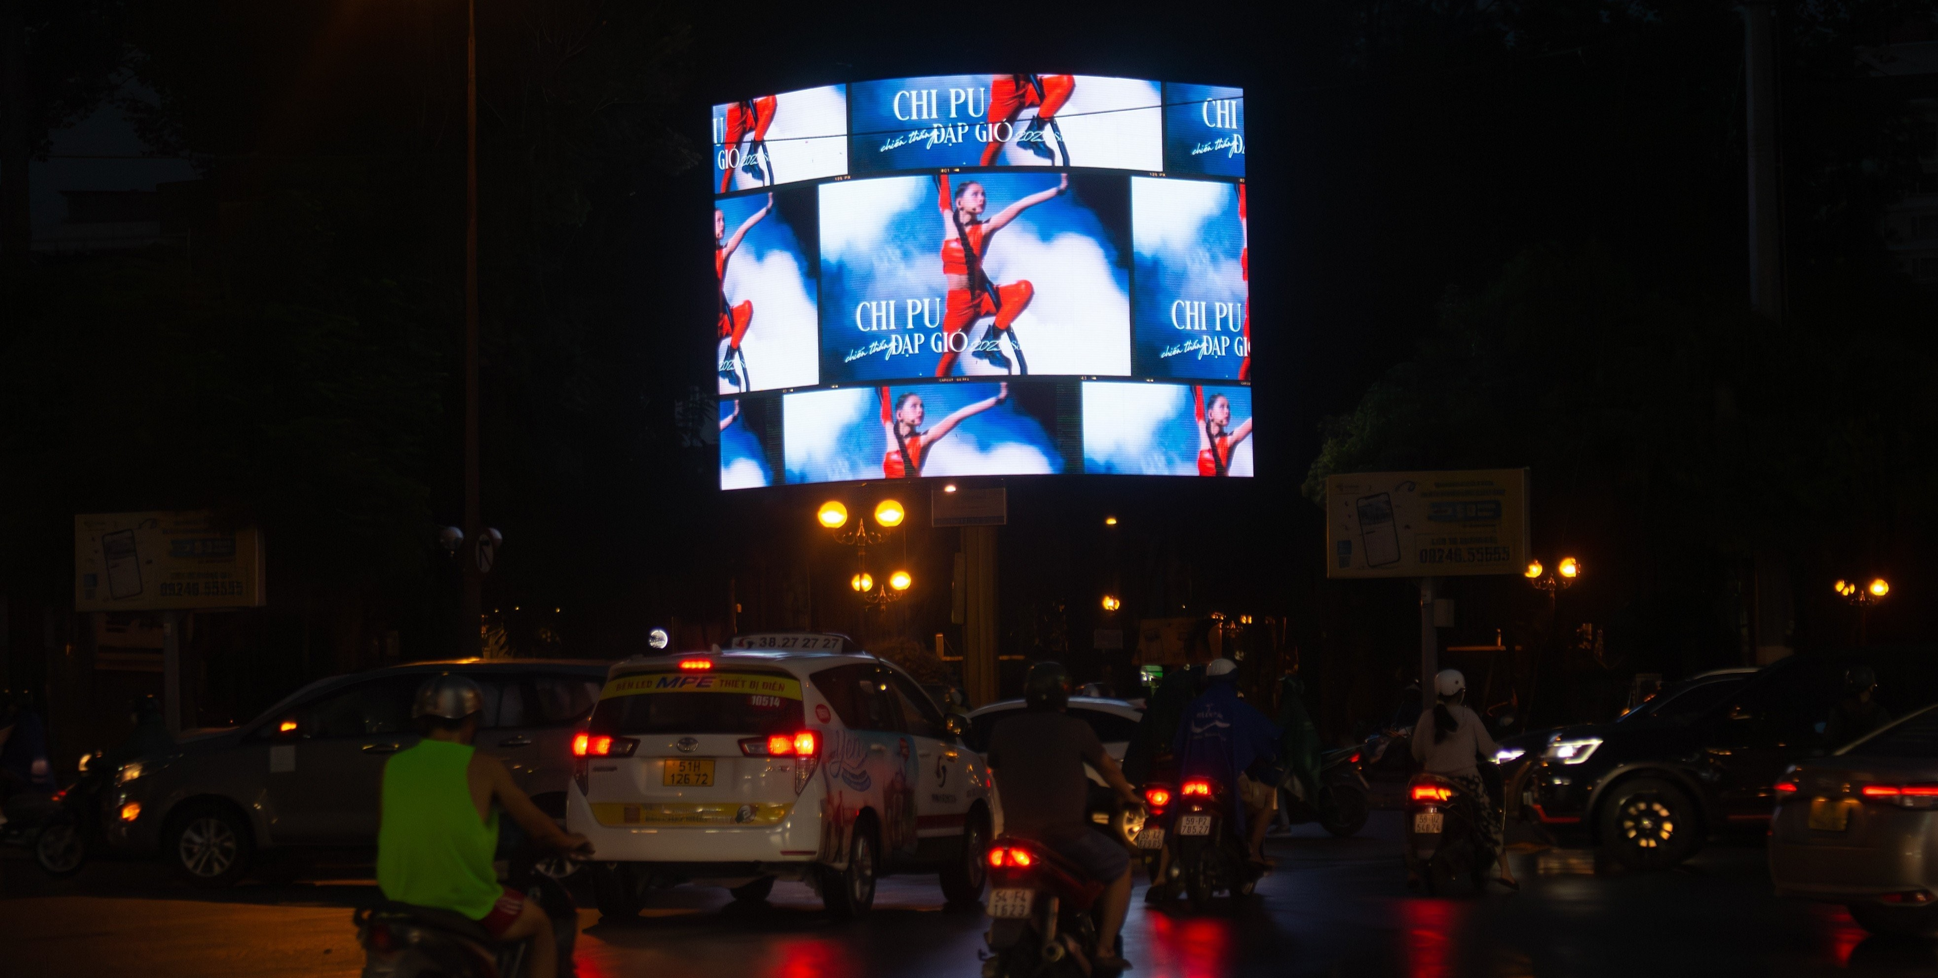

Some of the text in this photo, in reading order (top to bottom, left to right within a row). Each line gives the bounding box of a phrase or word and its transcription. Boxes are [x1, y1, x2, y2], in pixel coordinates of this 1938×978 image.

[893, 87, 985, 121] CHI PU
[1202, 98, 1238, 129] CHI
[975, 118, 1013, 143] GIÓ
[718, 145, 740, 170] GIÓ
[856, 298, 941, 332] CHI PU
[1171, 300, 1242, 332] CHI PU
[890, 333, 926, 358] ĐẠP
[930, 328, 969, 353] GIÓ
[1203, 335, 1231, 359] ĐẠP
[759, 637, 839, 649] 38.27 27 27
[656, 676, 716, 688] MPE
[751, 695, 781, 708] 10514
[679, 761, 701, 772] 51H
